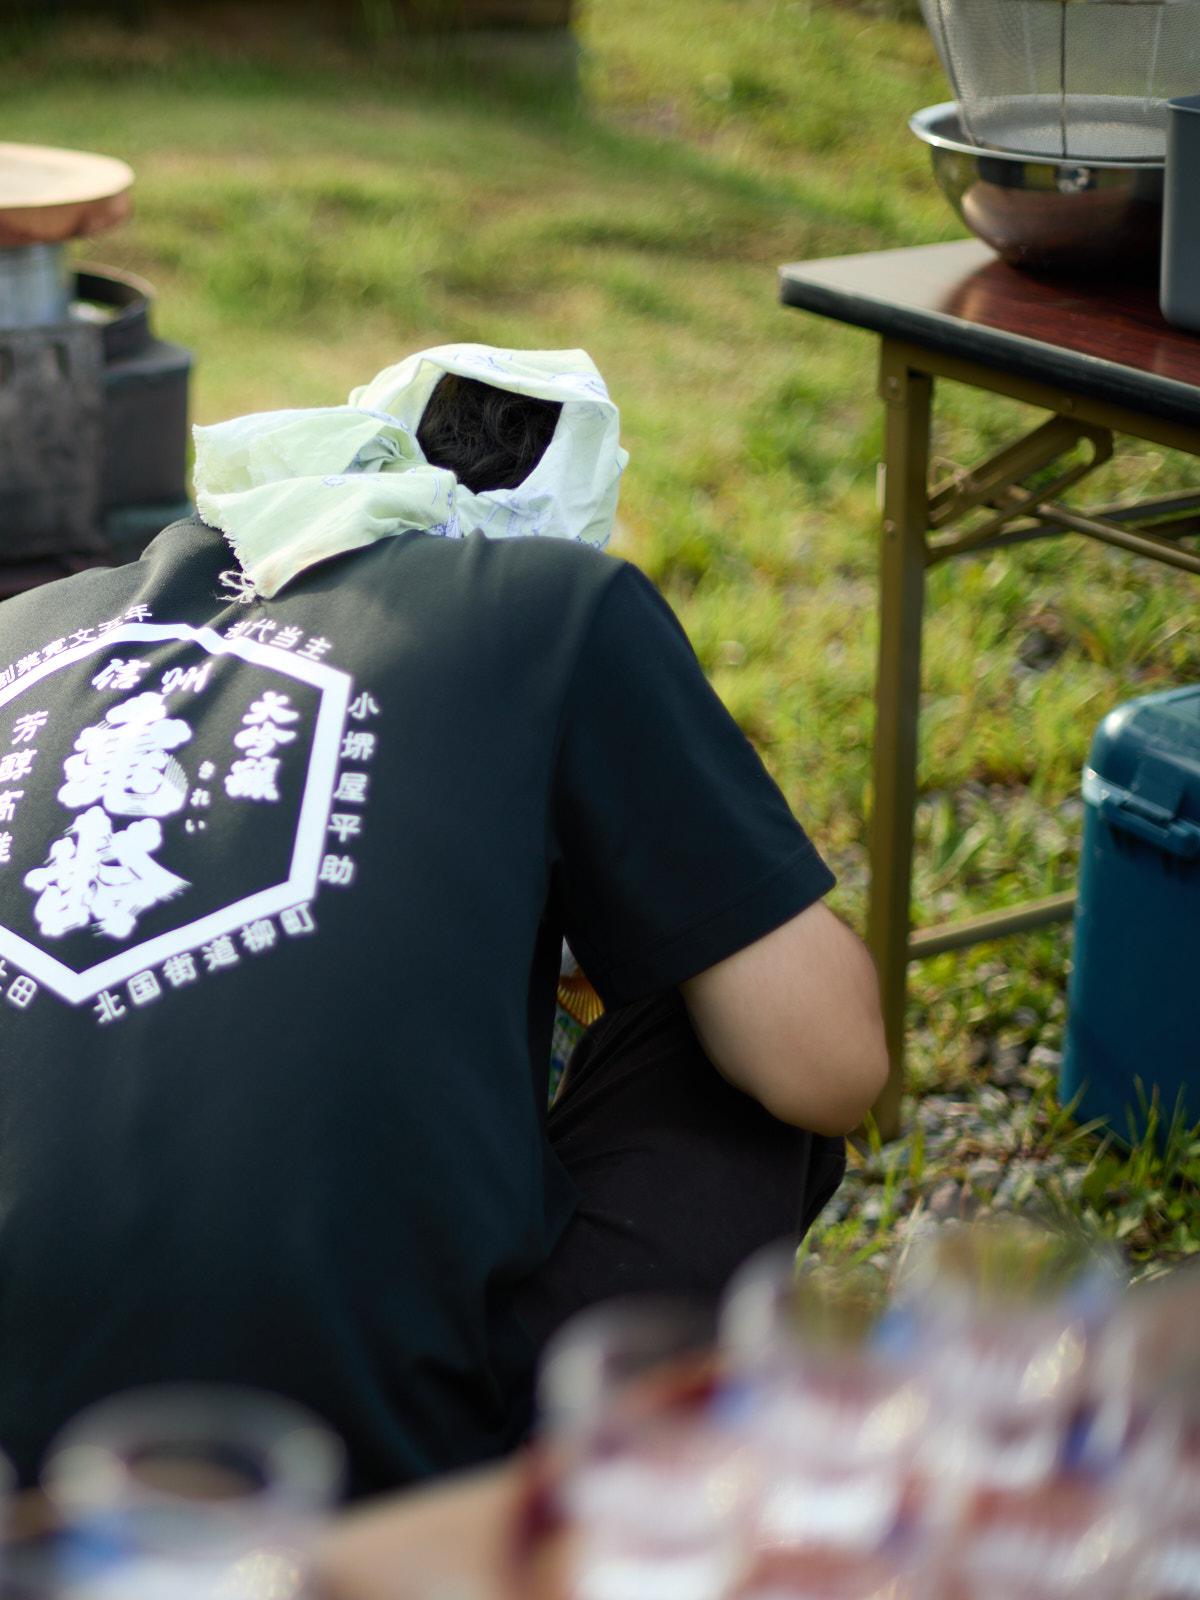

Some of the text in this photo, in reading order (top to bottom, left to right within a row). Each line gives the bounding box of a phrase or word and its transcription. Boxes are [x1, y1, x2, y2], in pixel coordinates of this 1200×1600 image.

[91, 658, 214, 694] 信州
[184, 760, 216, 833] きれい
[318, 691, 380, 885] 小堺屋平助
[92, 901, 316, 1025] 北国街道柳町
